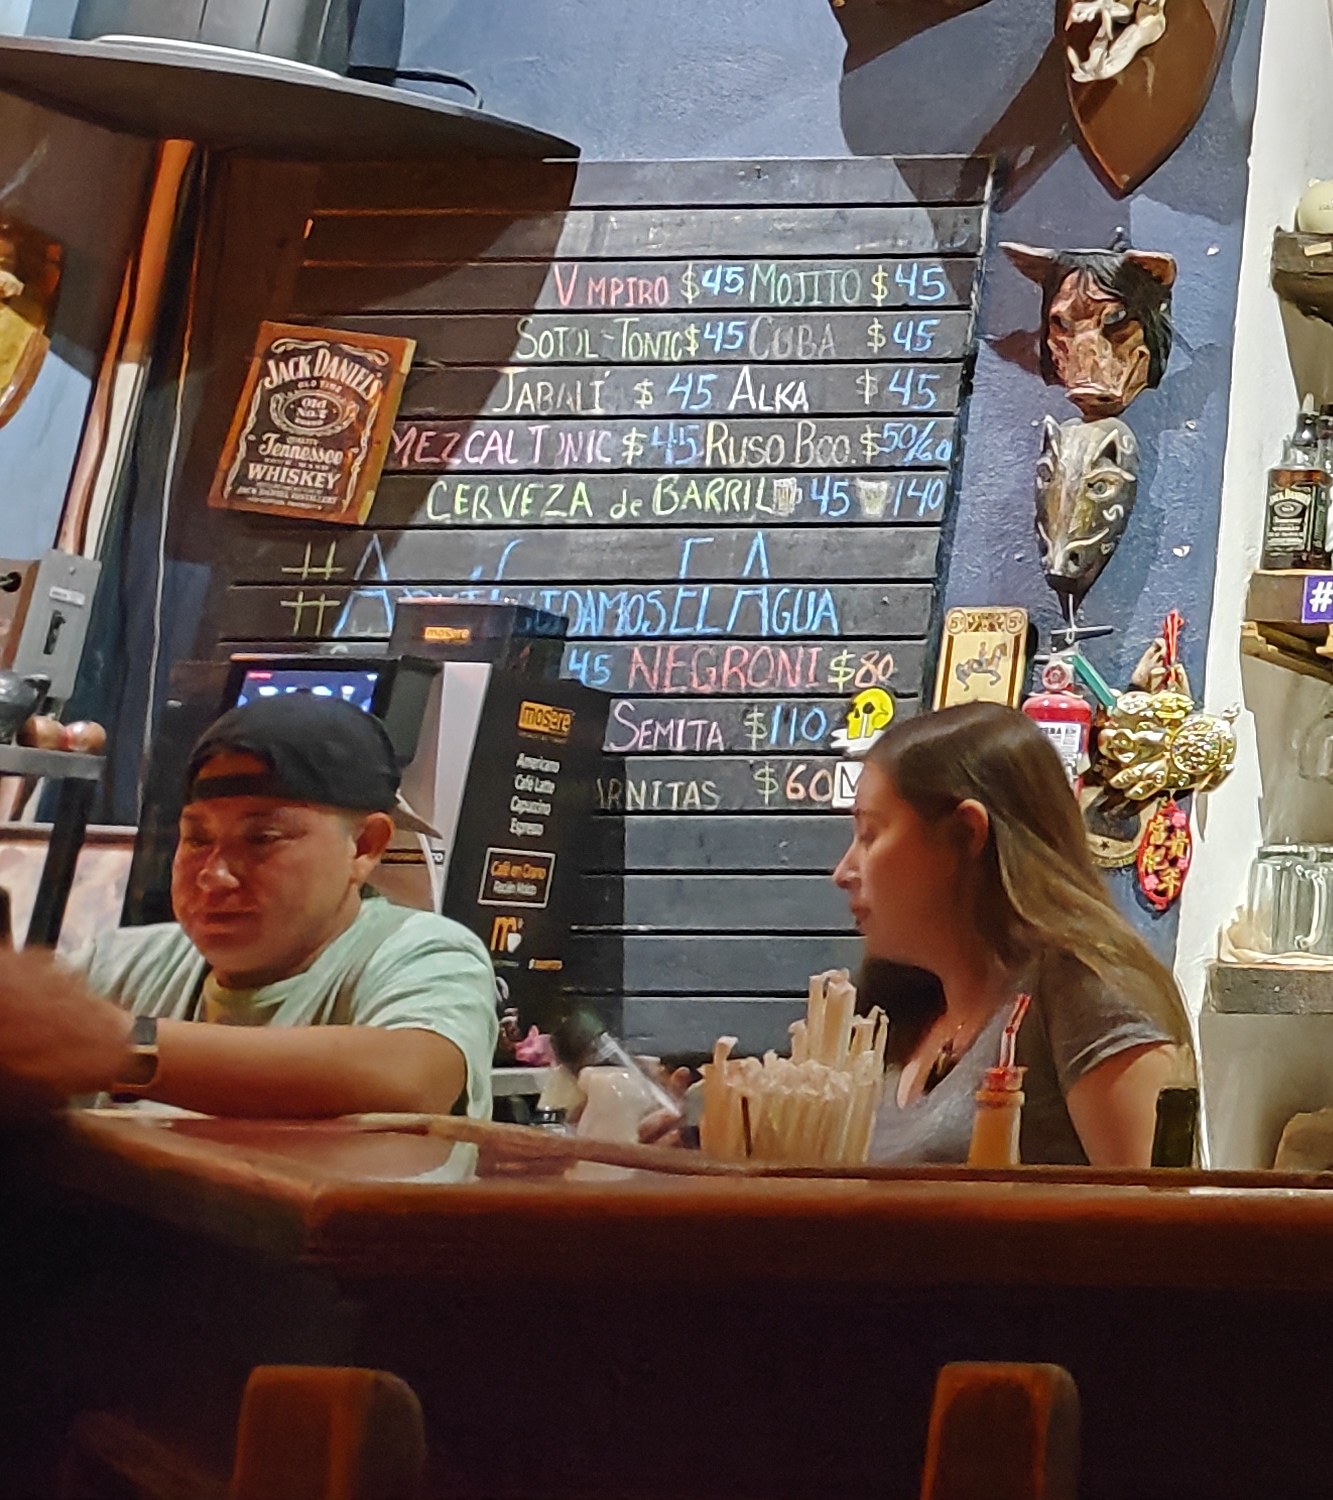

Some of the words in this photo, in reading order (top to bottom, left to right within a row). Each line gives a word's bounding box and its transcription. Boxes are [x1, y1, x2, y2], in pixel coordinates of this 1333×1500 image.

[749, 263, 862, 306] MOJITO
[748, 316, 837, 358] CUBA
[263, 355, 313, 389] JACK
[728, 366, 812, 411] ALKA
[391, 425, 519, 468] MEZCAL
[705, 419, 785, 468] RUSO
[247, 462, 342, 490] WHISKEY
[426, 478, 594, 521] CERVEZA
[609, 489, 644, 521] de
[652, 474, 774, 518] BARRIL
[811, 475, 851, 518] 45
[568, 652, 613, 687] 45
[628, 646, 823, 692] NEGRONI
[522, 704, 572, 734] mosere
[607, 701, 726, 752] SEMITA
